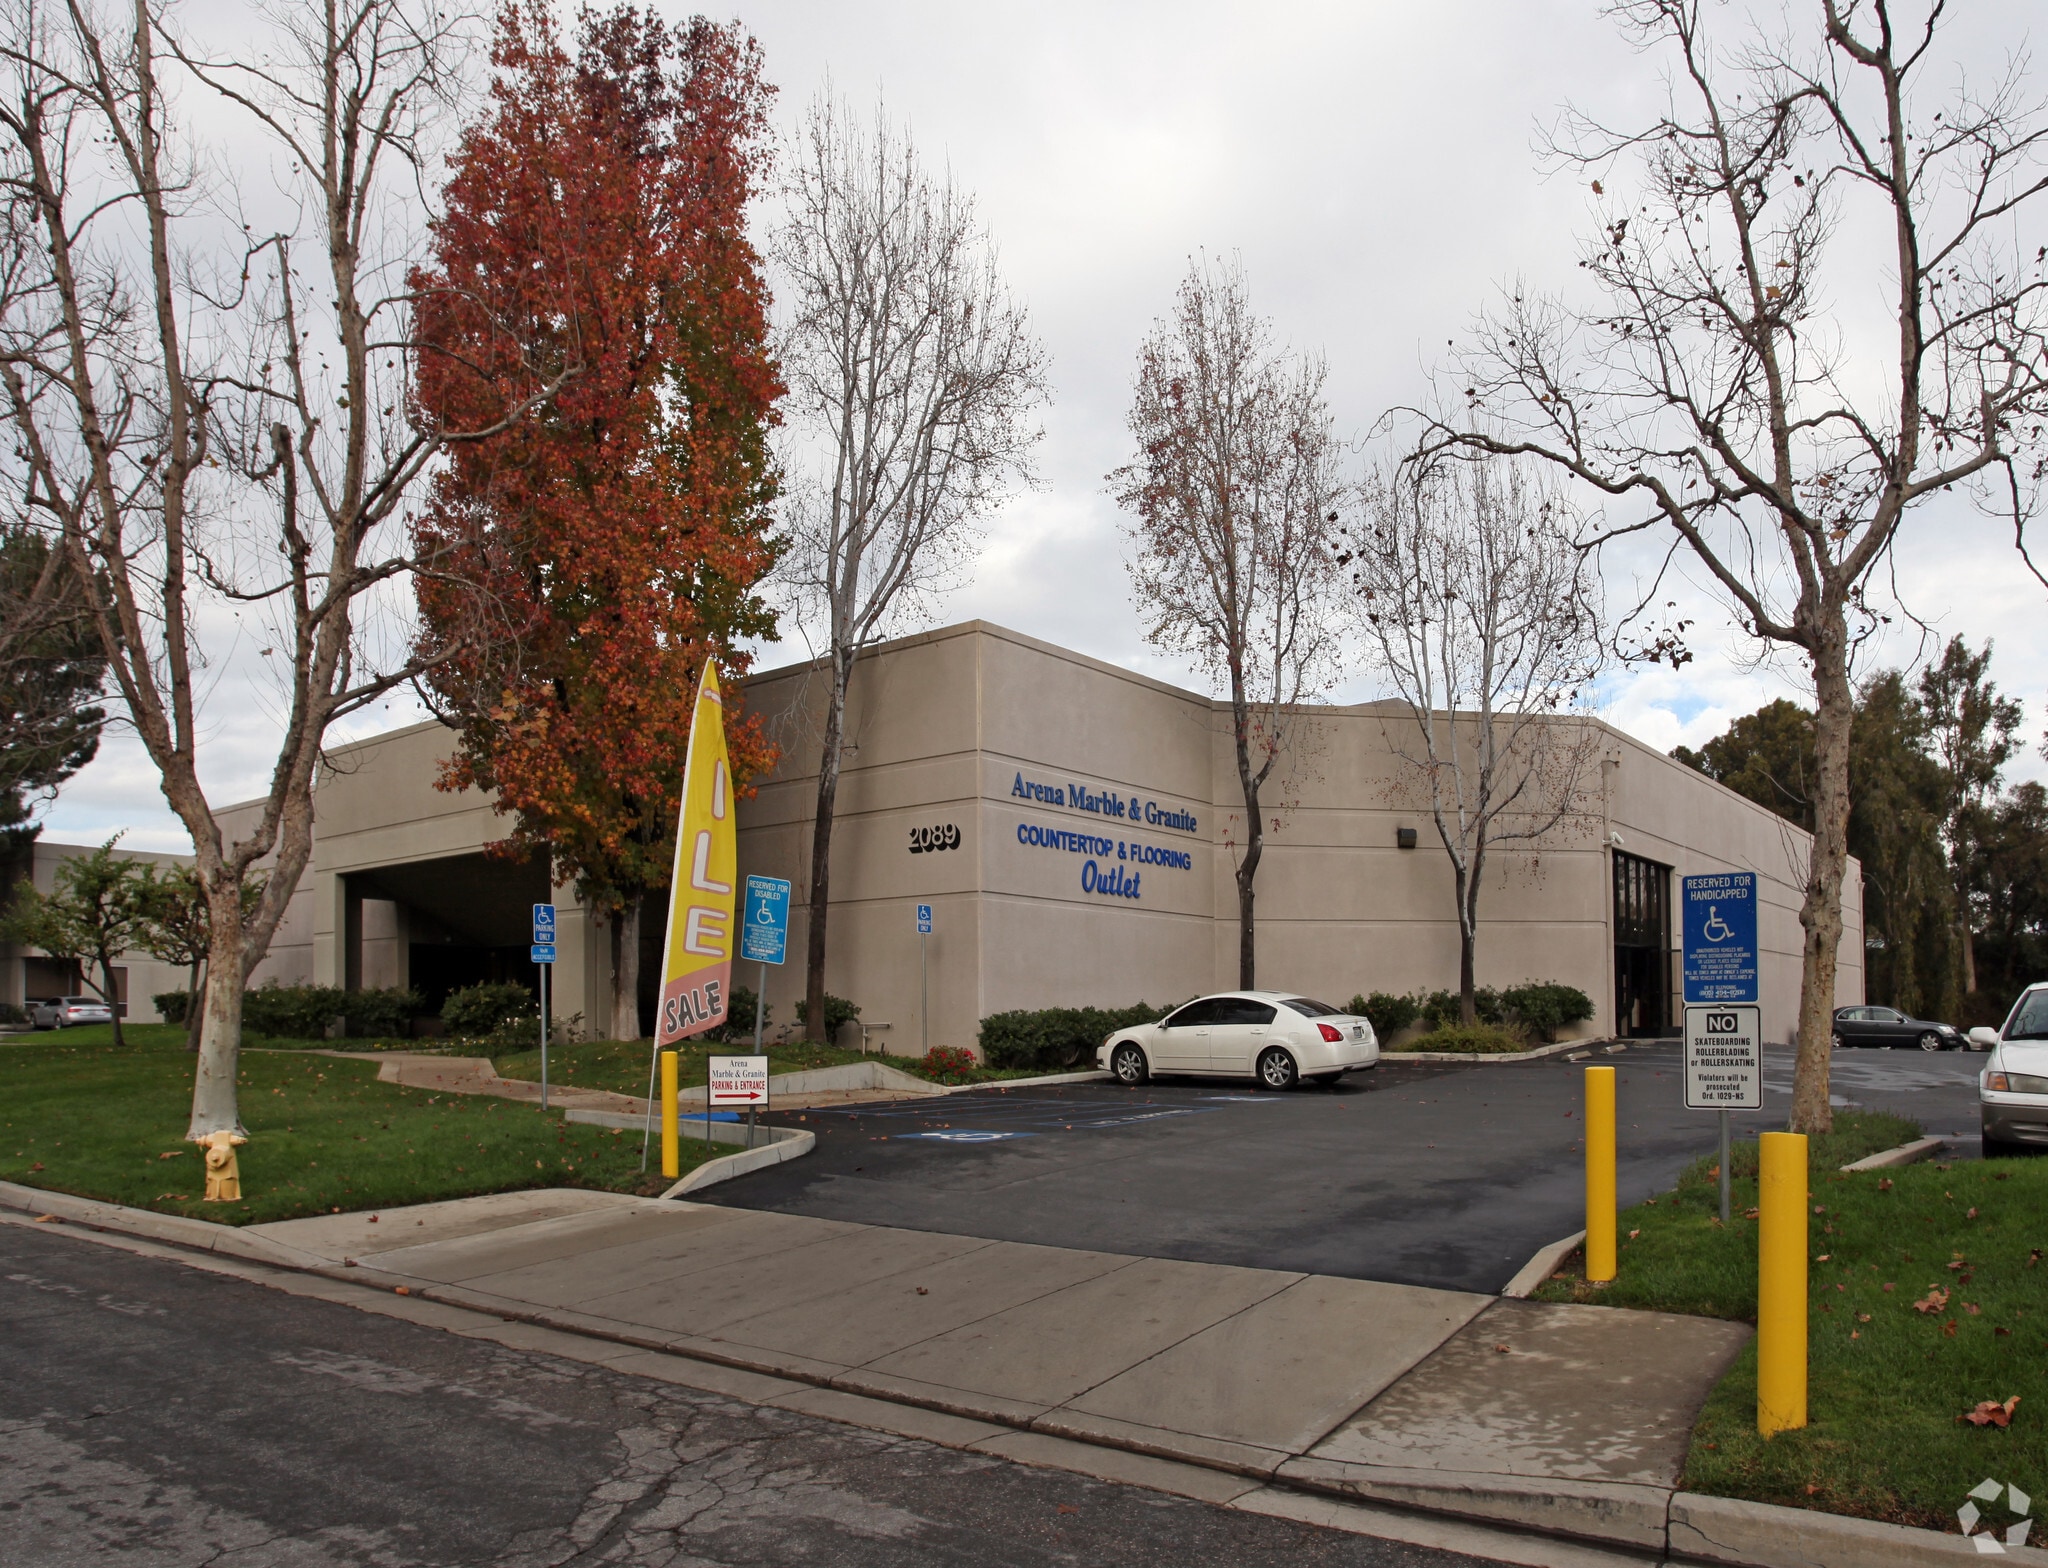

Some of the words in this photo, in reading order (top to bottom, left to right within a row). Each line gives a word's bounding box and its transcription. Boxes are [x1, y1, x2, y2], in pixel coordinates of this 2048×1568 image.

[1011, 772, 1064, 806] Arena
[1068, 784, 1125, 818] Marble
[1128, 797, 1141, 821] &
[1145, 801, 1197, 832] Granite
[908, 823, 961, 854] 2089
[1017, 823, 1113, 857] COUNTERTOP
[1117, 841, 1127, 860] &
[1130, 843, 1191, 870] FLOORING
[1081, 859, 1140, 898] Outlet
[1687, 877, 1730, 890] RESERVED
[1734, 876, 1751, 886] FOR
[749, 880, 776, 891] RESERVED
[778, 884, 788, 893] FOR
[754, 889, 780, 900] DISABLED
[1690, 888, 1748, 901] HANDICAPPED
[666, 980, 723, 1034] SALE
[1708, 1016, 1736, 1031] NO
[1694, 1038, 1750, 1046] SKATEBOARDING
[712, 1081, 732, 1090] PARKING
[735, 1081, 738, 1090] &
[740, 1081, 765, 1090] ENTRANCE
